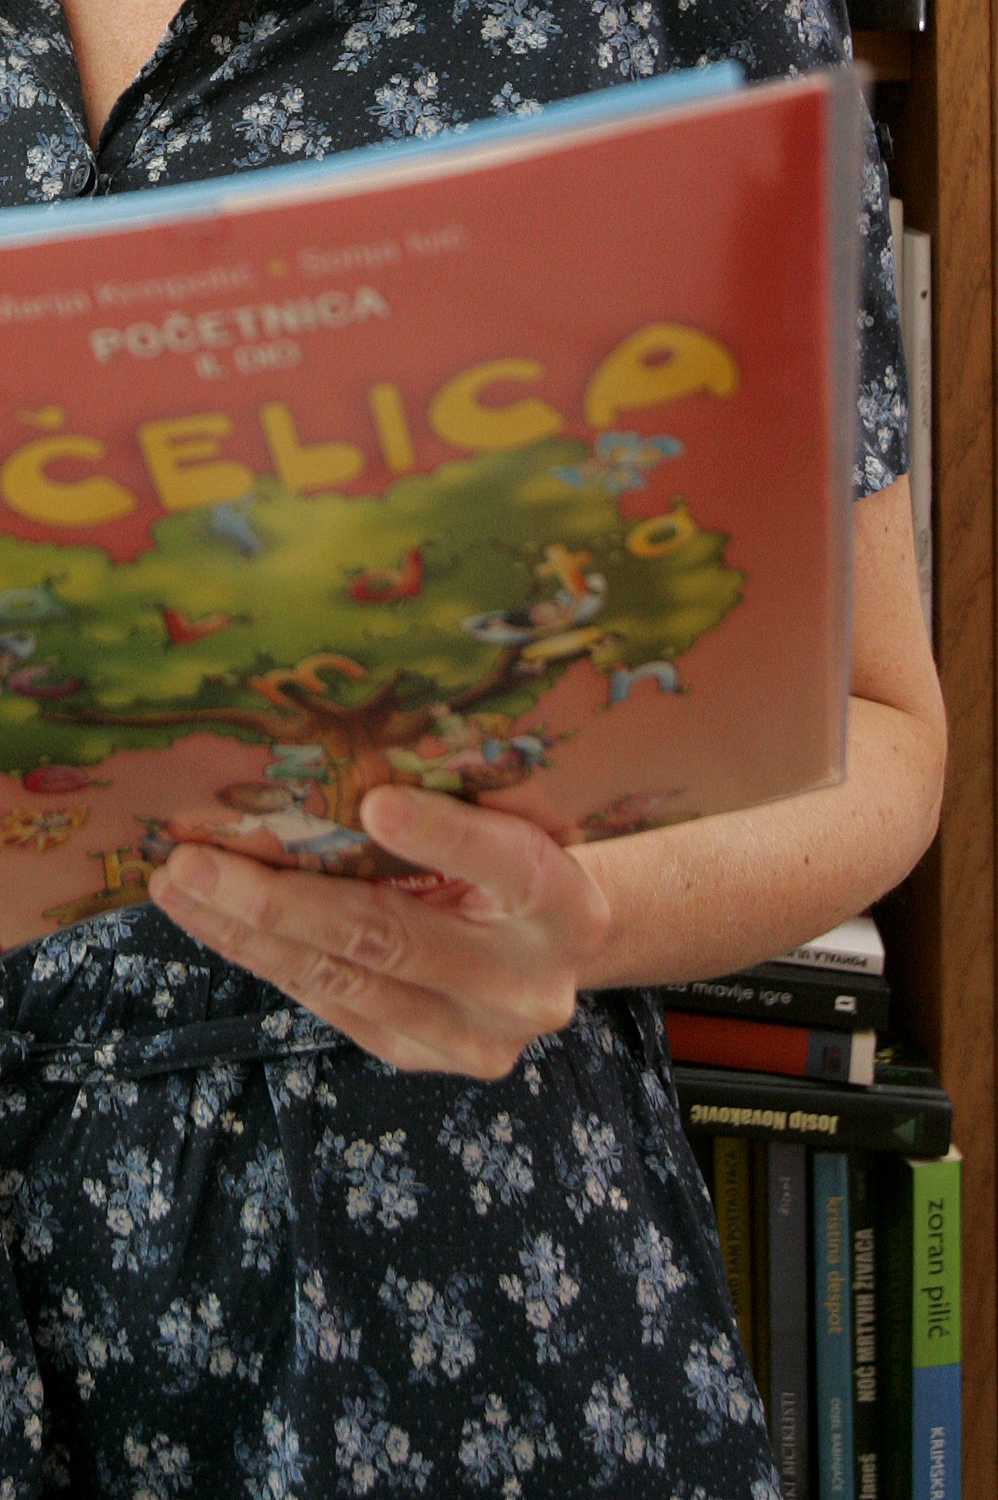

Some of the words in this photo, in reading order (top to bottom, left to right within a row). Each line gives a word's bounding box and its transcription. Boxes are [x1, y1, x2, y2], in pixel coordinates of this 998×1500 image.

[87, 284, 391, 364] POČETNICA
[758, 990, 793, 1006] igre
[689, 1103, 788, 1131] Novaković
[788, 1111, 840, 1136] Josip
[825, 1195, 846, 1266] kristina
[852, 1227, 875, 1291] ŽIVACA
[927, 1196, 947, 1276] zoran
[825, 1269, 846, 1335] despot
[855, 1293, 876, 1362] MRTVIH
[921, 1286, 951, 1340] pilić
[855, 1365, 877, 1403] NOĆ
